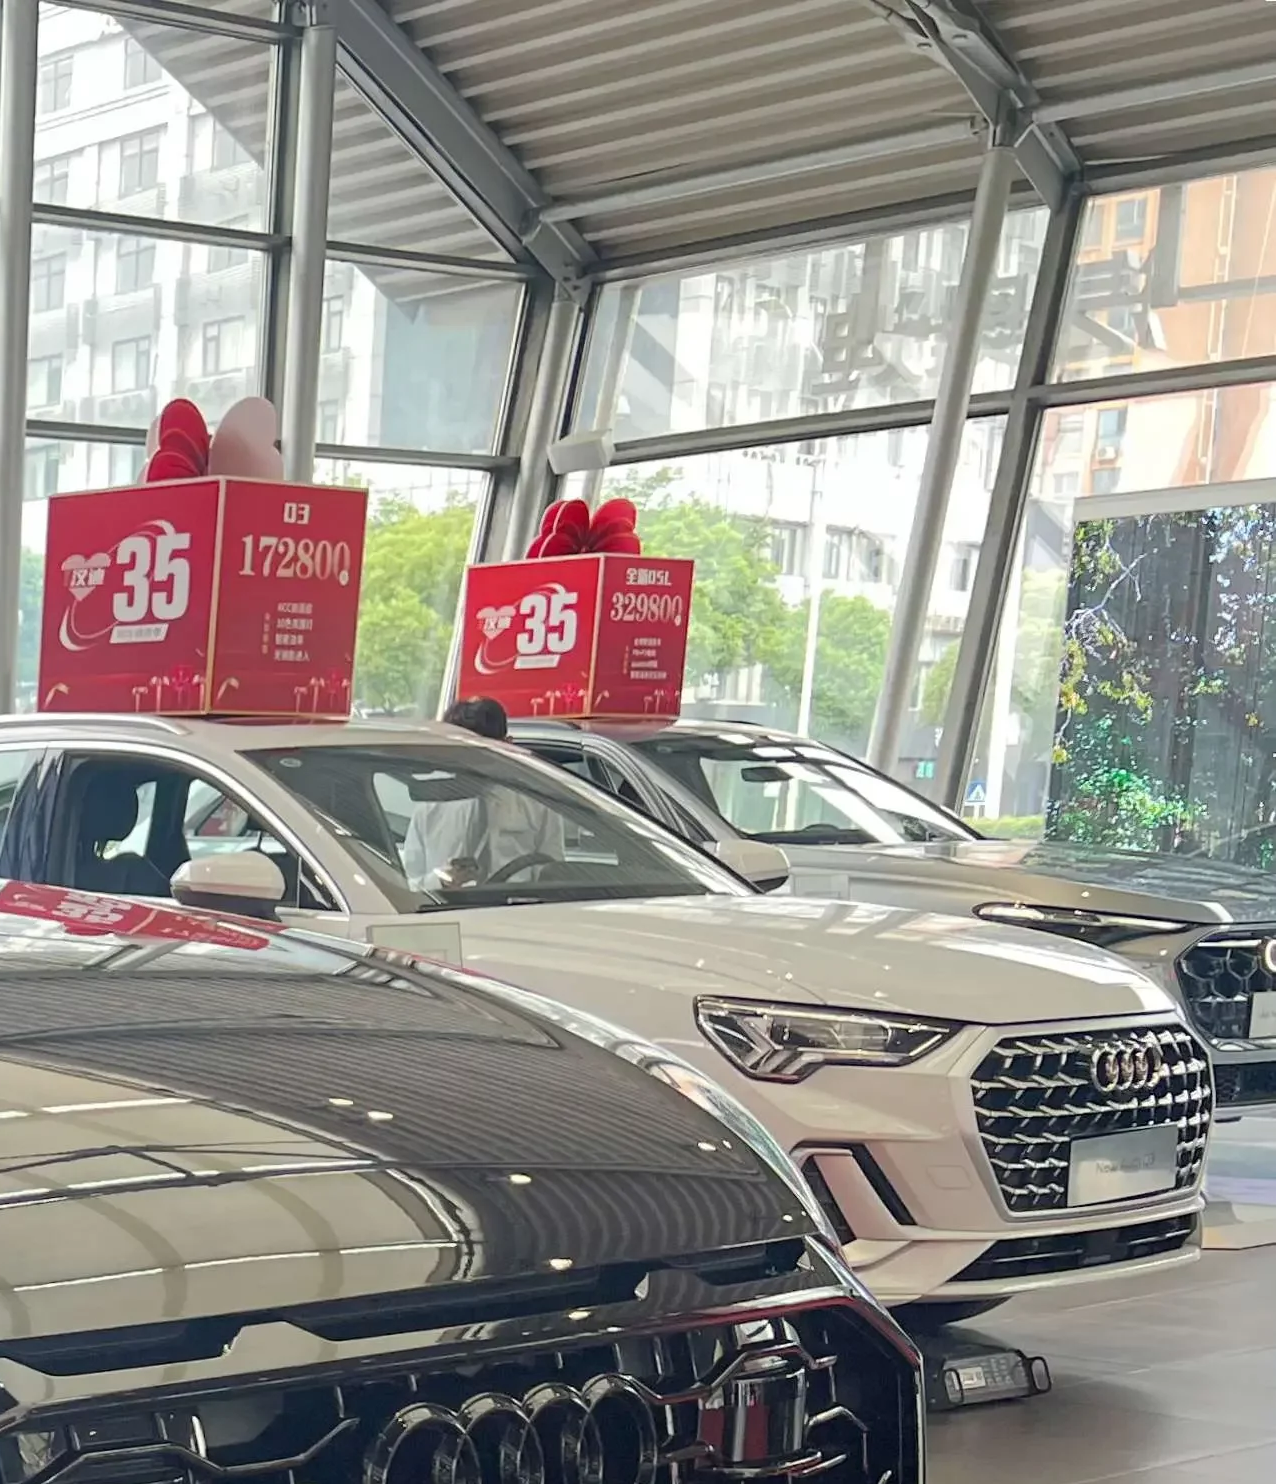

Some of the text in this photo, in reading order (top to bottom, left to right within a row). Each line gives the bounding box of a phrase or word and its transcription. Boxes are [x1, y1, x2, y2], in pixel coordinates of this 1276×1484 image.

[112, 533, 192, 622] 35
[238, 534, 351, 582] 172800
[515, 592, 579, 655] 35
